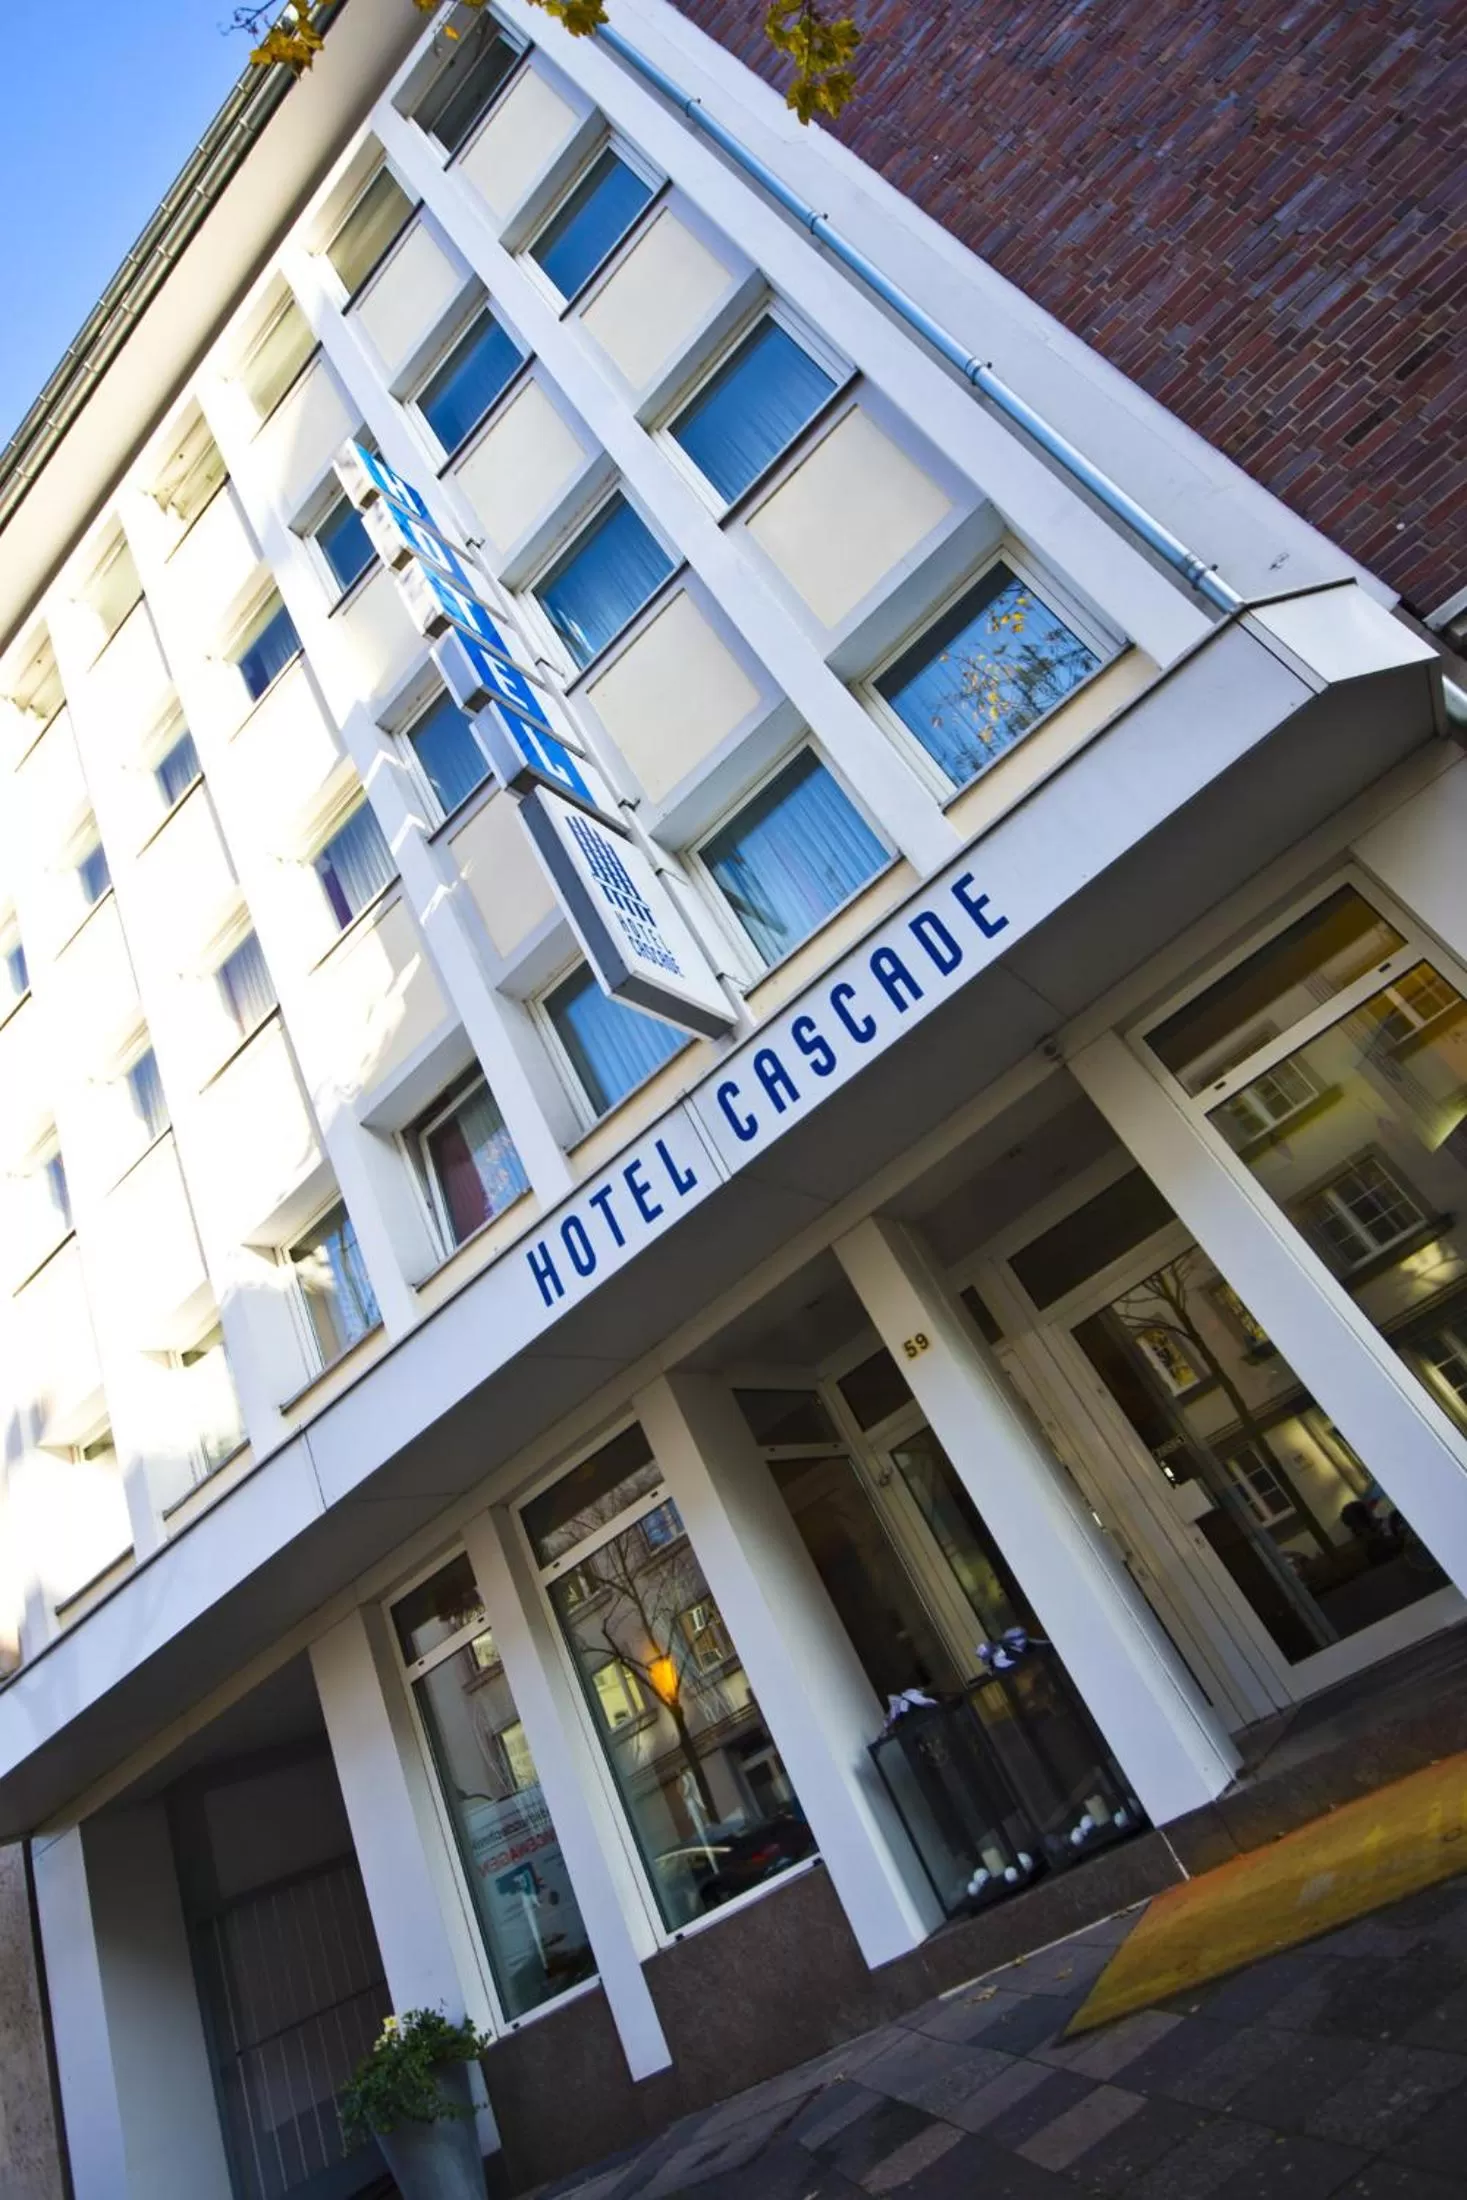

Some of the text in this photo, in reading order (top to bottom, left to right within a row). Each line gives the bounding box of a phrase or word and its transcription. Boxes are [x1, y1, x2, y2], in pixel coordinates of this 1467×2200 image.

[526, 872, 1010, 1307] HOTEL CASCADE
[903, 1332, 929, 1358] 59
